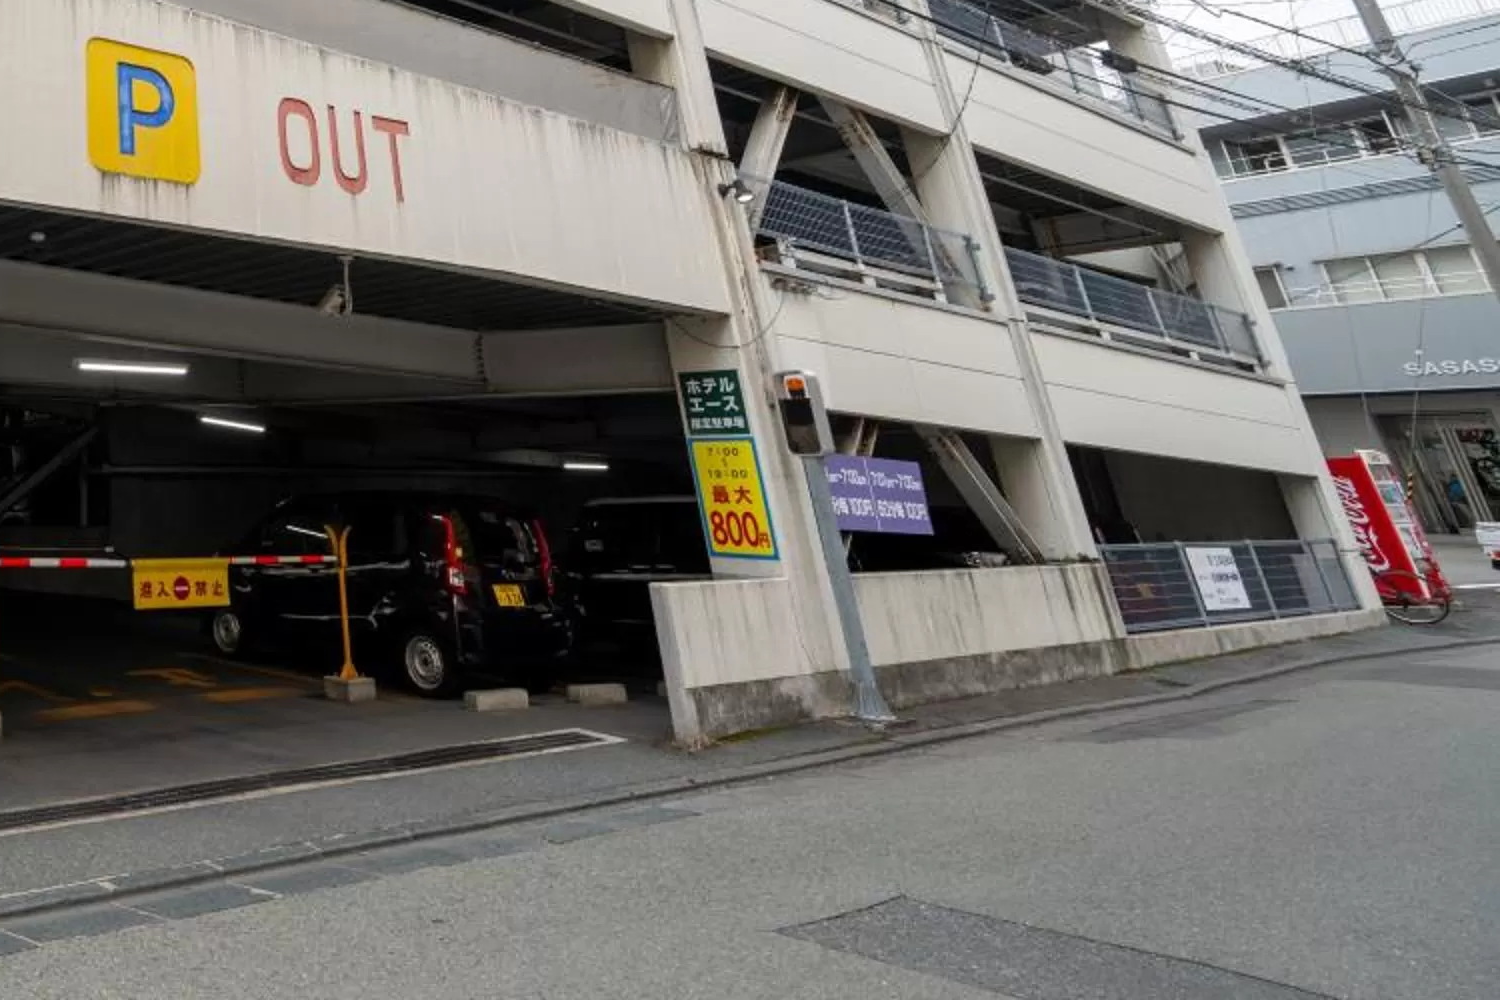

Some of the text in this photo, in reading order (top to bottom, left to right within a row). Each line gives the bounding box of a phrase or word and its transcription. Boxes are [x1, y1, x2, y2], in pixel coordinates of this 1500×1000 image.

[117, 60, 176, 156] P
[277, 95, 410, 205] OUT
[1402, 357, 1500, 377] SASAS
[686, 376, 735, 395] ホテル
[689, 395, 740, 412] エース
[711, 484, 753, 505] 最大
[710, 509, 771, 549] 800円
